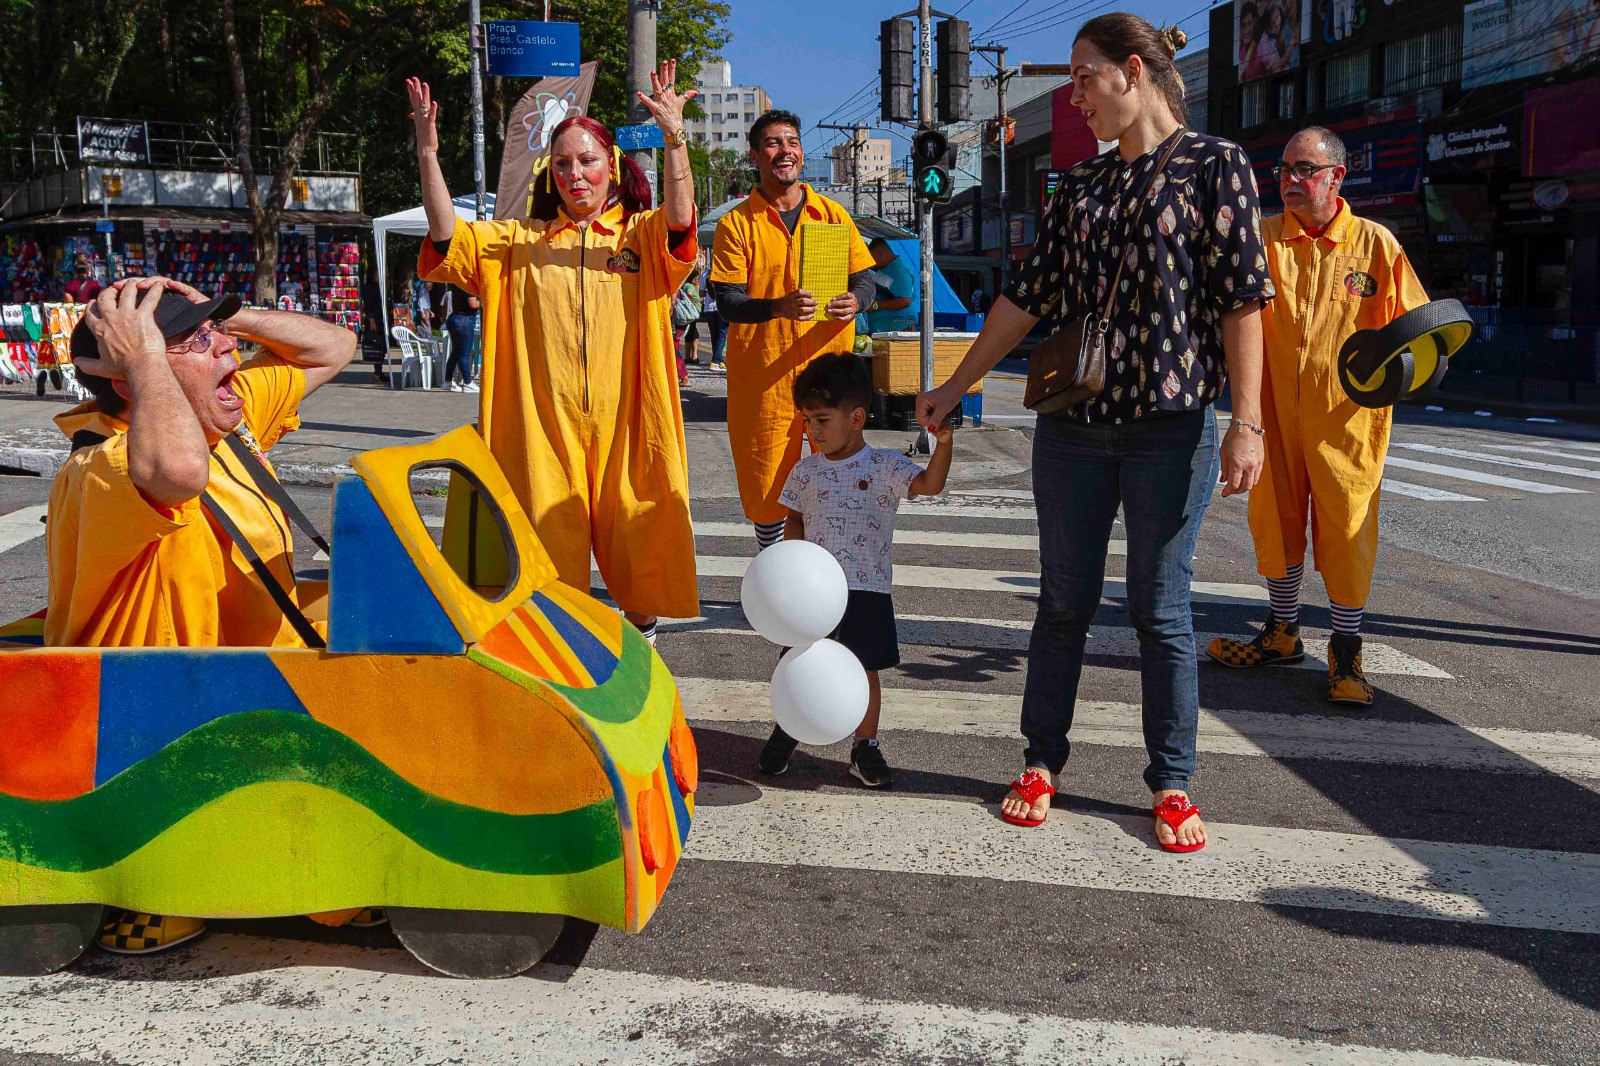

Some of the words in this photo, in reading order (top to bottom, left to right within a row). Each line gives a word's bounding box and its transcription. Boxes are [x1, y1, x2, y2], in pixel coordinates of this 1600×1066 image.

[489, 24, 516, 35] Praça
[489, 34, 514, 44] Pres.
[516, 34, 556, 45] Castelo
[490, 45, 524, 55] Branco
[1445, 145, 1474, 157] Universo
[1474, 142, 1484, 153] do
[1484, 139, 1511, 151] Sorriso
